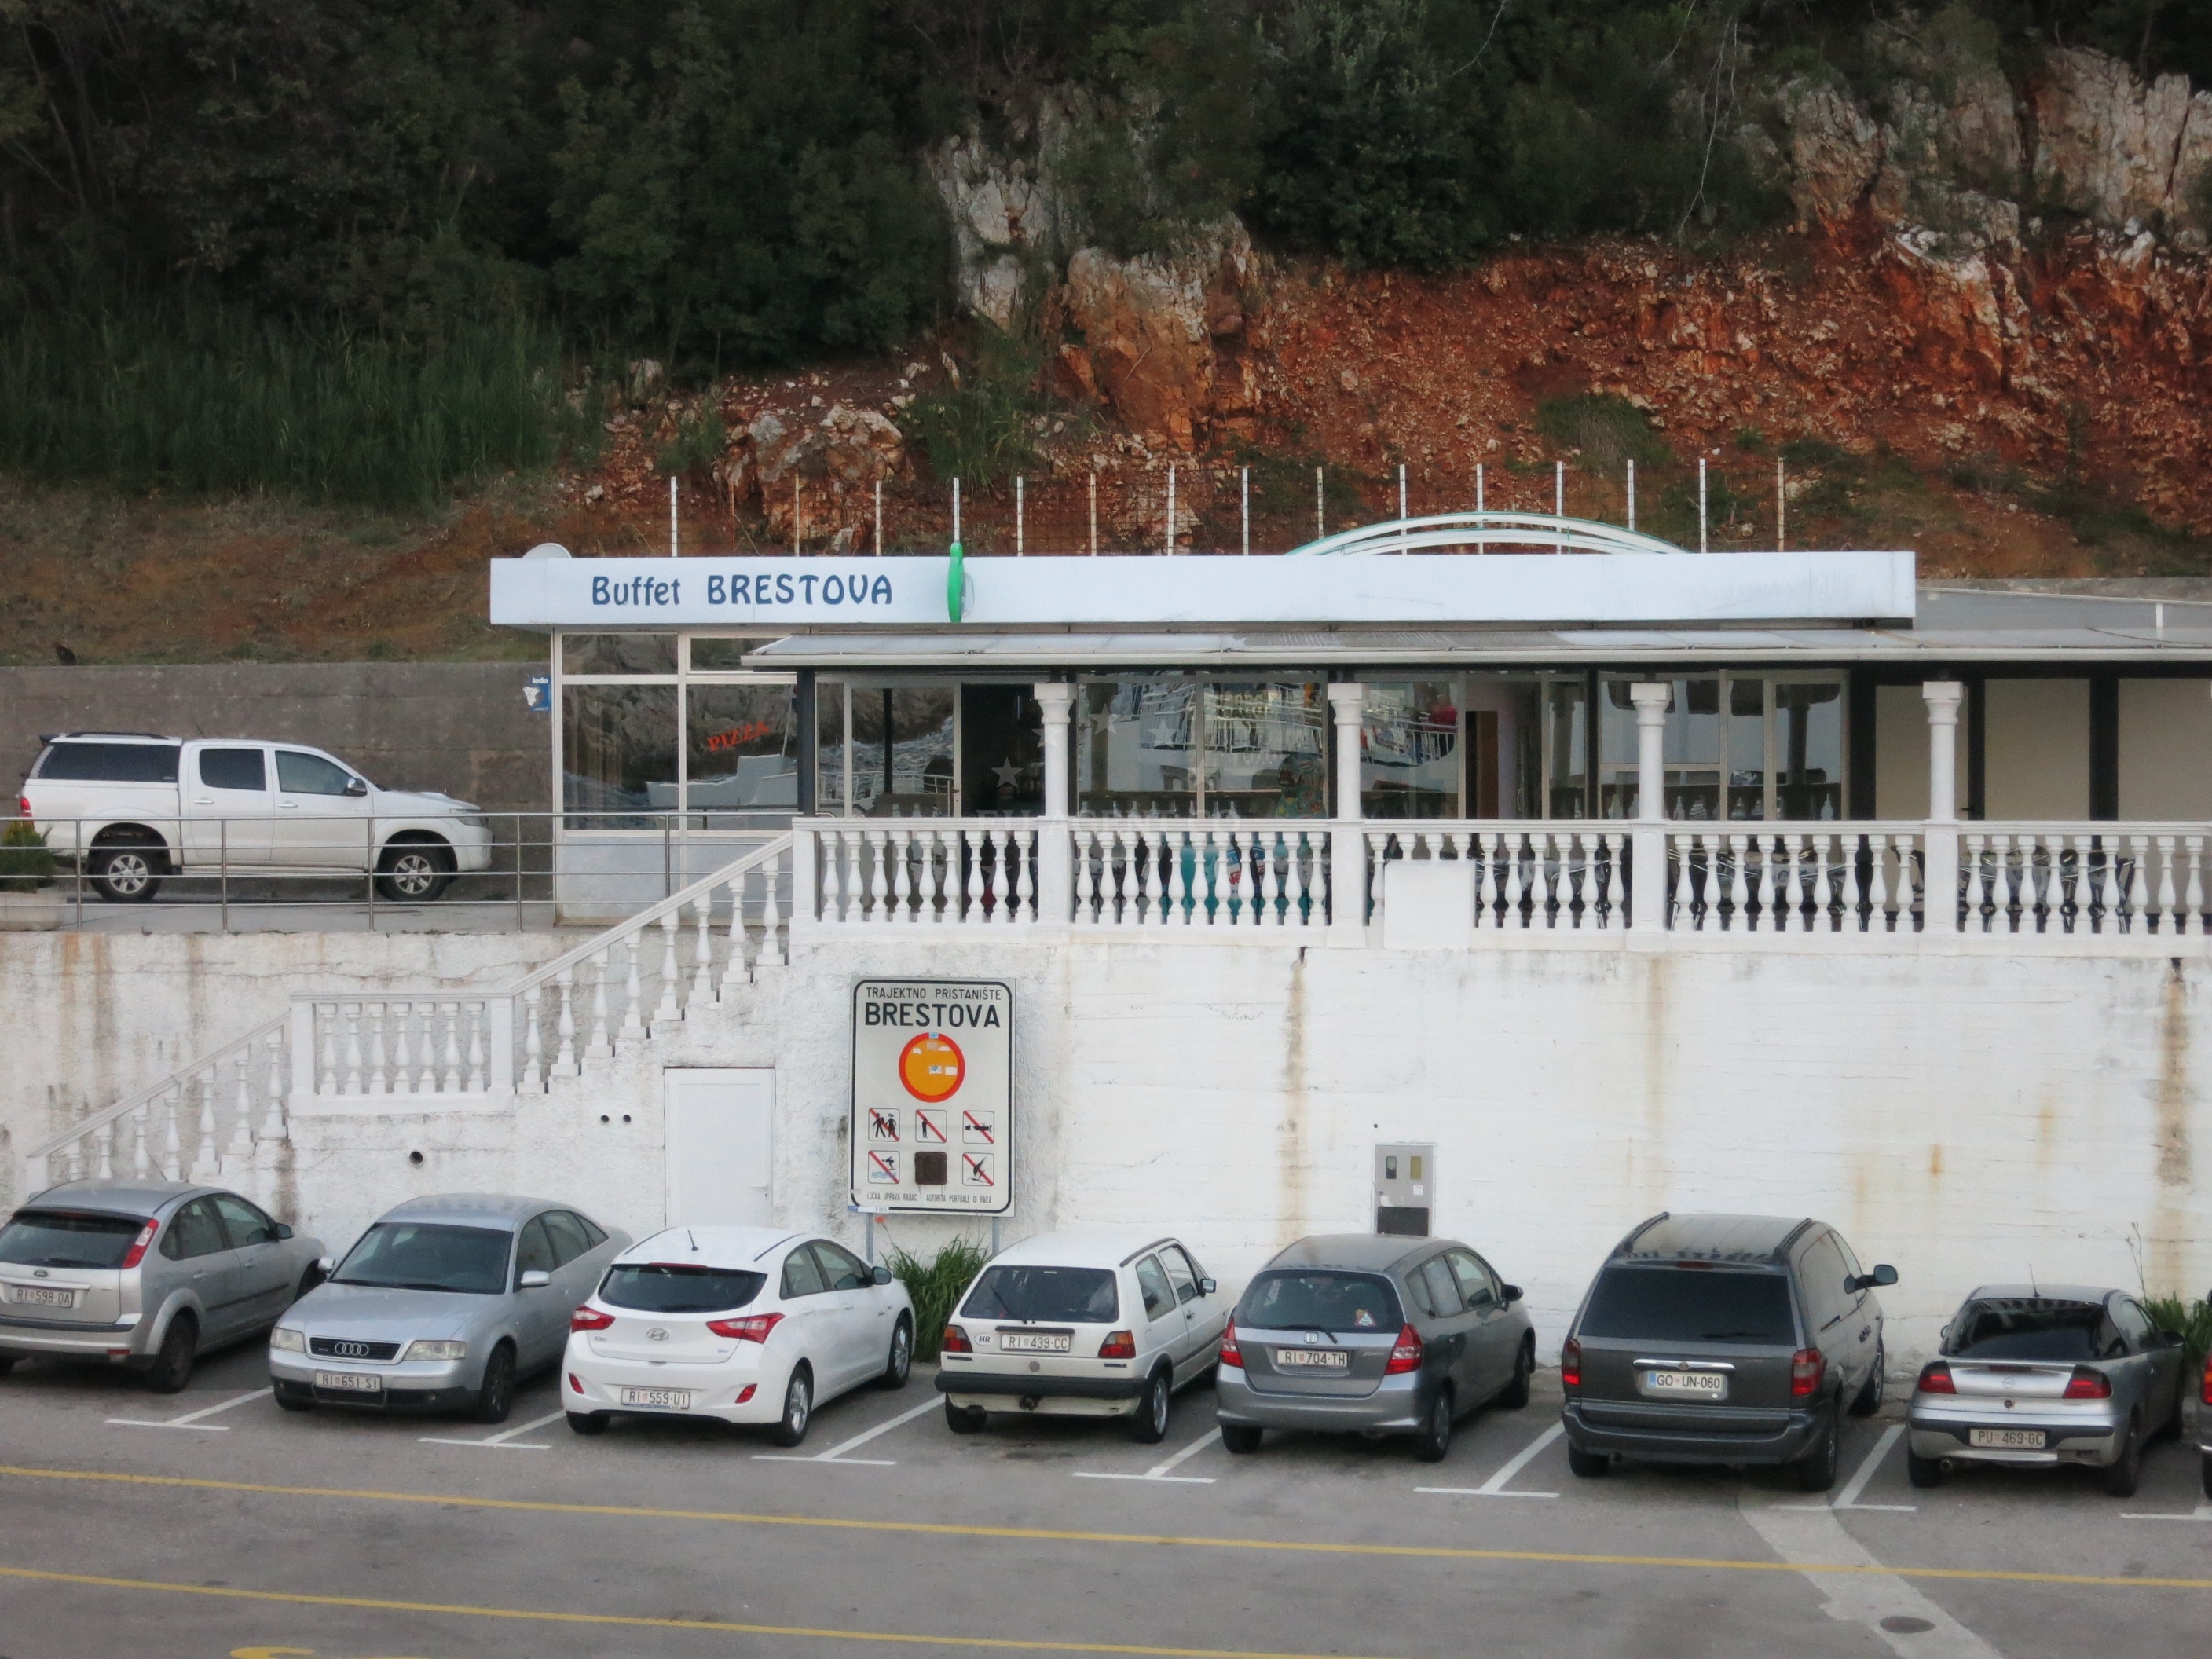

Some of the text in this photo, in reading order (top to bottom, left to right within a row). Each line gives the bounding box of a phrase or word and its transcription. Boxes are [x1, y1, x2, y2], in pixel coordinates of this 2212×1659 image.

[591, 573, 892, 606] Buffet BRESTOVA
[708, 721, 769, 753] PIZZA
[866, 987, 1002, 1001] TRAJEKTNO PRISTANIŠTE
[865, 1002, 1001, 1028] BRESTOVA
[17, 1289, 27, 1301] RI
[1009, 1336, 1068, 1350] RI 439-CC
[1285, 1351, 1296, 1363] RI
[322, 1374, 333, 1386] RI
[1657, 1374, 1720, 1389] GO UN-060
[628, 1390, 640, 1403] RI
[1978, 1430, 1994, 1444] PU
